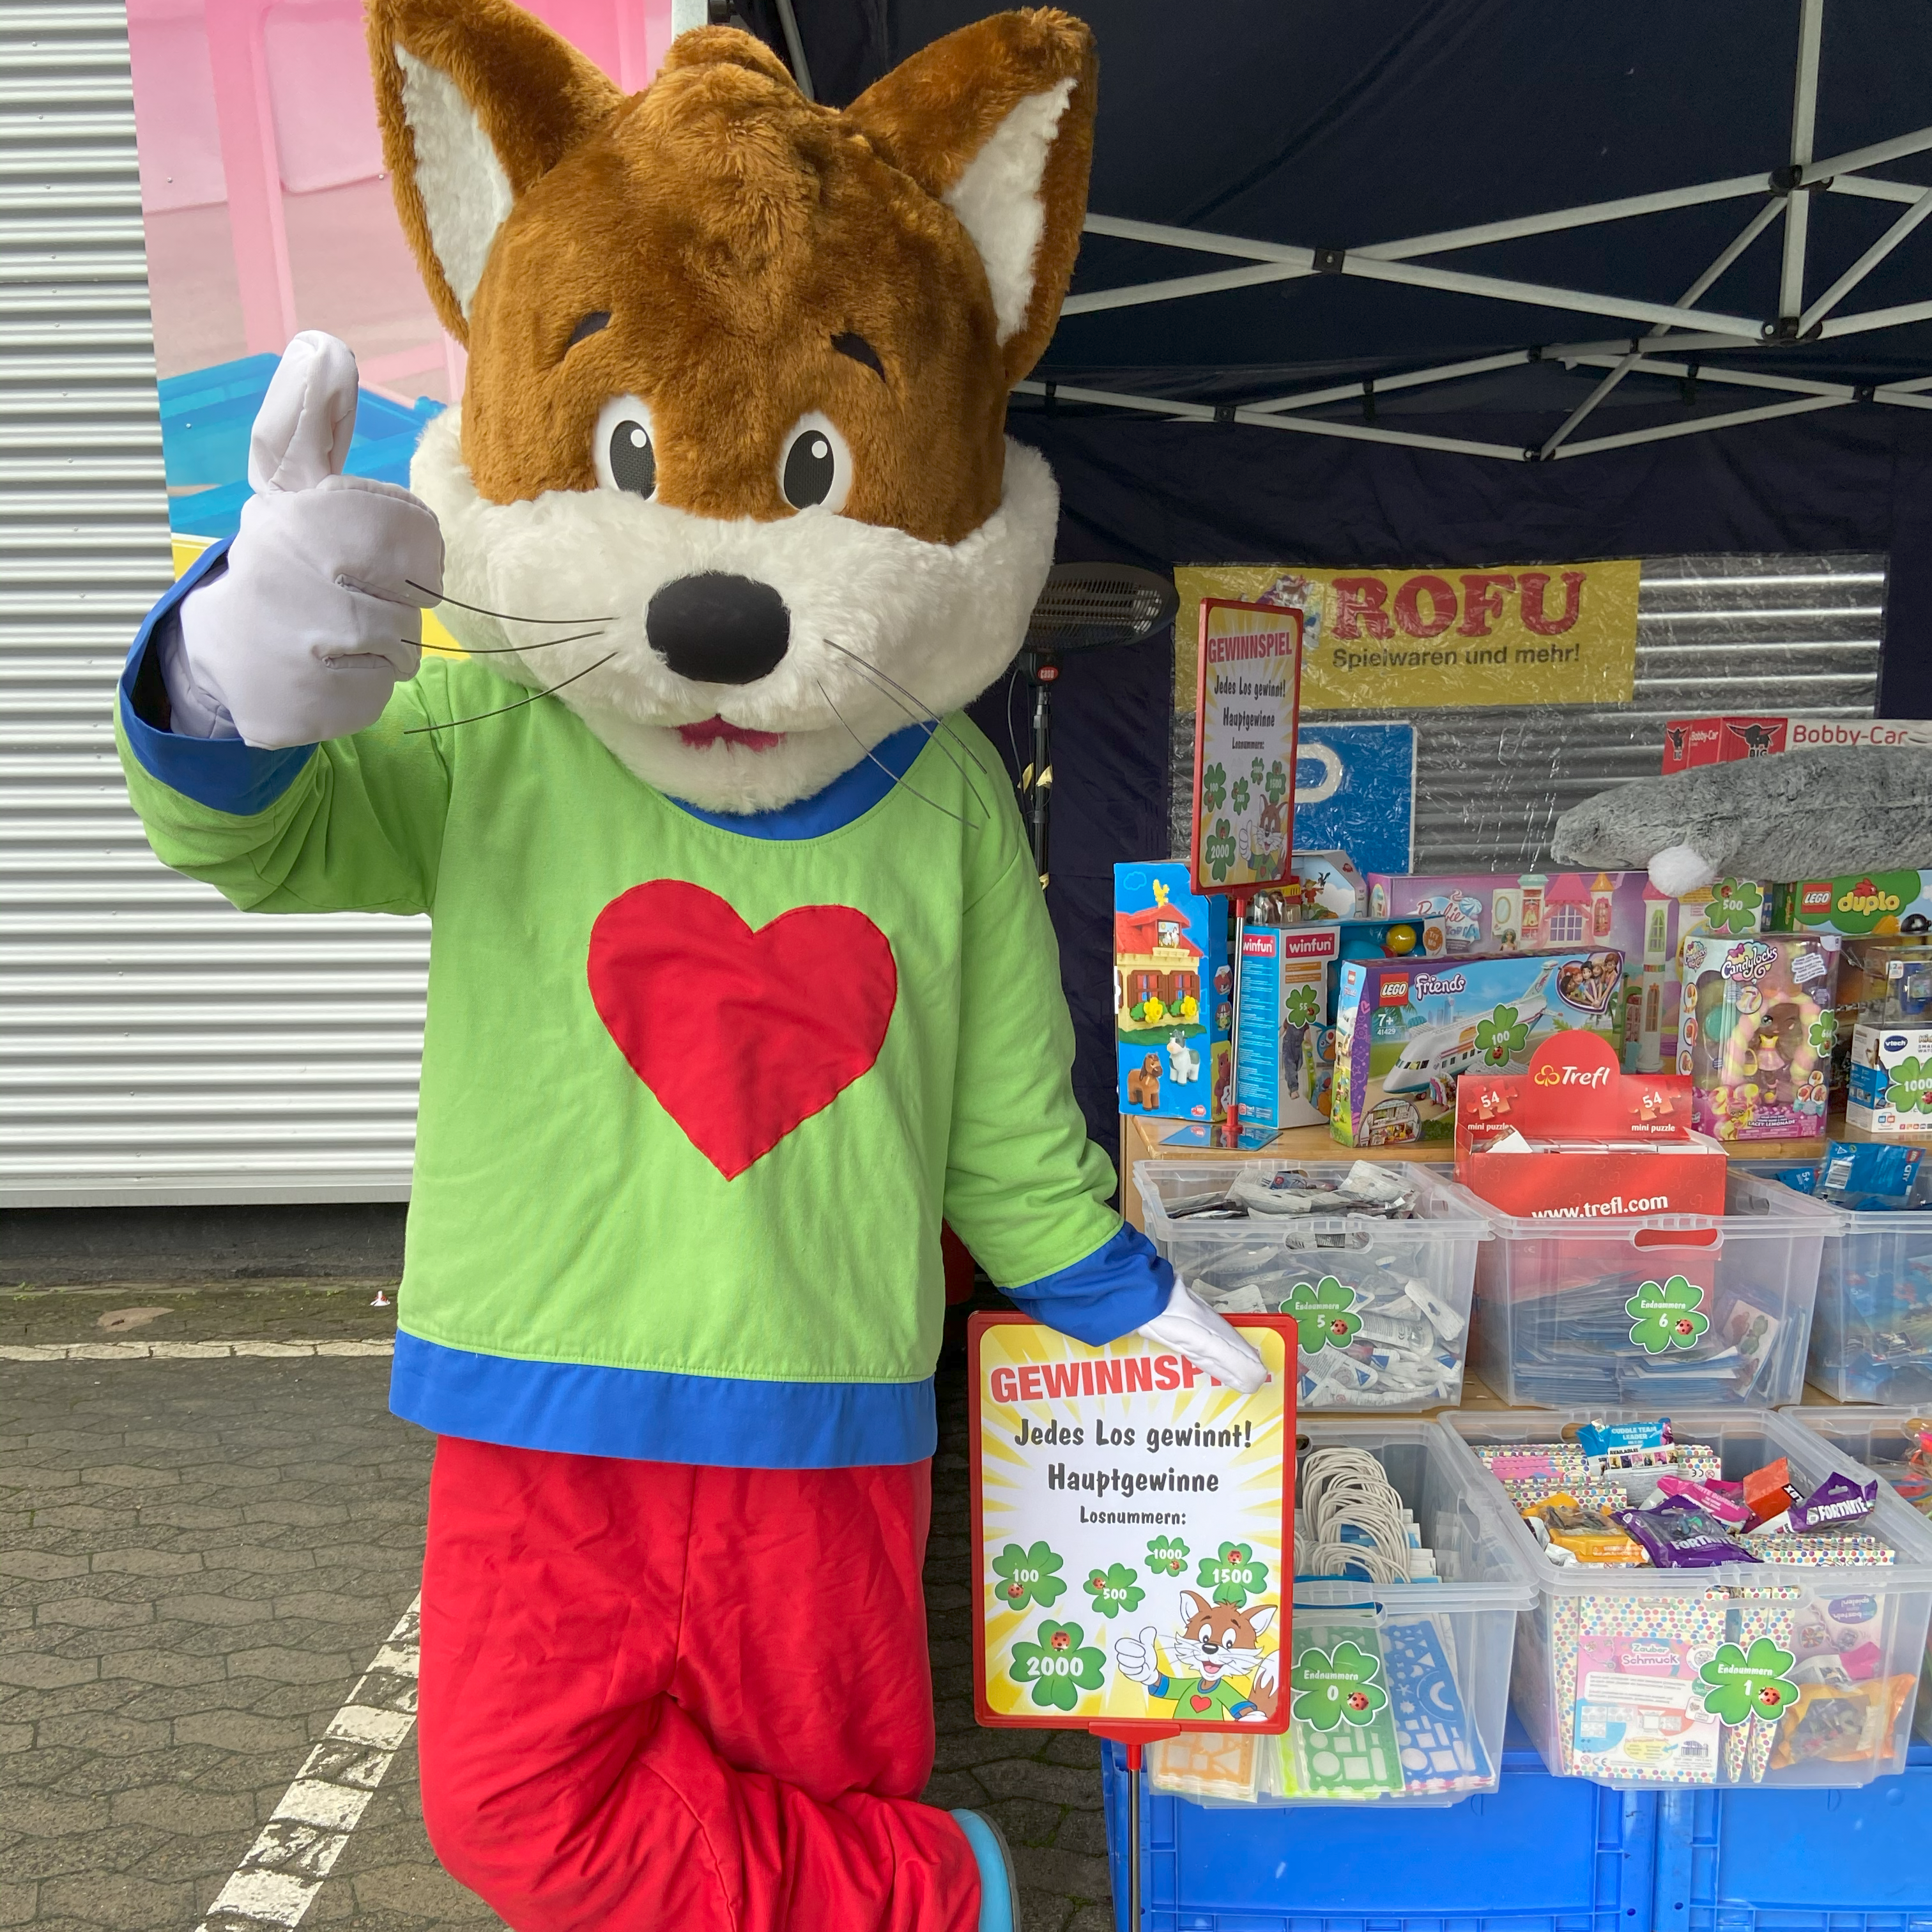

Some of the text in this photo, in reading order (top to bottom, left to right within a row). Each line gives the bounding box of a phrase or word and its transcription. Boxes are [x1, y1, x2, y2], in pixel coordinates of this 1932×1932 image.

[1331, 572, 1586, 640] ROFU
[1208, 632, 1292, 664] GEWINNSPIEL
[1333, 643, 1579, 671] Spielwaren und mehr!
[1215, 675, 1285, 700] Jedes Los gewinnt!
[1223, 707, 1275, 731] Hauptgewinne
[1690, 730, 1719, 743] Bobby-Car
[1793, 725, 1908, 746] Bobby-Car
[1232, 737, 1265, 750] Losnummern:
[1211, 844, 1230, 859] 2000
[1722, 900, 1743, 911] 500
[1804, 891, 1900, 916] LEGO duplo
[1429, 931, 1439, 940] Try
[1243, 938, 1273, 953] winfun
[1289, 938, 1331, 953] winfun
[1721, 947, 1778, 979] Candylocks
[1381, 982, 1407, 997] LEGO
[1299, 1002, 1308, 1011] 55
[1377, 1013, 1394, 1027] 7+
[1491, 1031, 1510, 1044] 100
[1561, 1066, 1611, 1089] Trefl
[1905, 1078, 1932, 1092] 1000
[1480, 1091, 1500, 1108] 54
[1643, 1091, 1662, 1108] 54
[1651, 1124, 1676, 1133] puzzle
[1802, 1171, 1810, 1181] 5+
[1531, 1195, 1668, 1218] www.trefl.com
[1295, 1301, 1339, 1310] Endnummern
[1640, 1300, 1686, 1310] Endnummern
[1317, 1314, 1326, 1328] 5
[1659, 1313, 1668, 1328] 6
[991, 1349, 1271, 1403] GEWINNSP
[1015, 1418, 1252, 1453] Jedes Los gewinnt!
[1048, 1463, 1220, 1498] Hauptgewinne
[1080, 1505, 1186, 1525] Losnummern:
[1818, 1496, 1867, 1520] FORTNITE
[1153, 1548, 1183, 1561] 1000
[1013, 1568, 1039, 1583] 100
[1213, 1568, 1254, 1584] 1500
[1103, 1588, 1127, 1600] 500
[1633, 1644, 1668, 1653] Zauber
[1027, 1657, 1084, 1676] 2000
[1717, 1664, 1773, 1676] Endnummern
[1303, 1669, 1358, 1681] Endnummern
[1327, 1685, 1339, 1701] 0
[1744, 1680, 1752, 1696] 1
